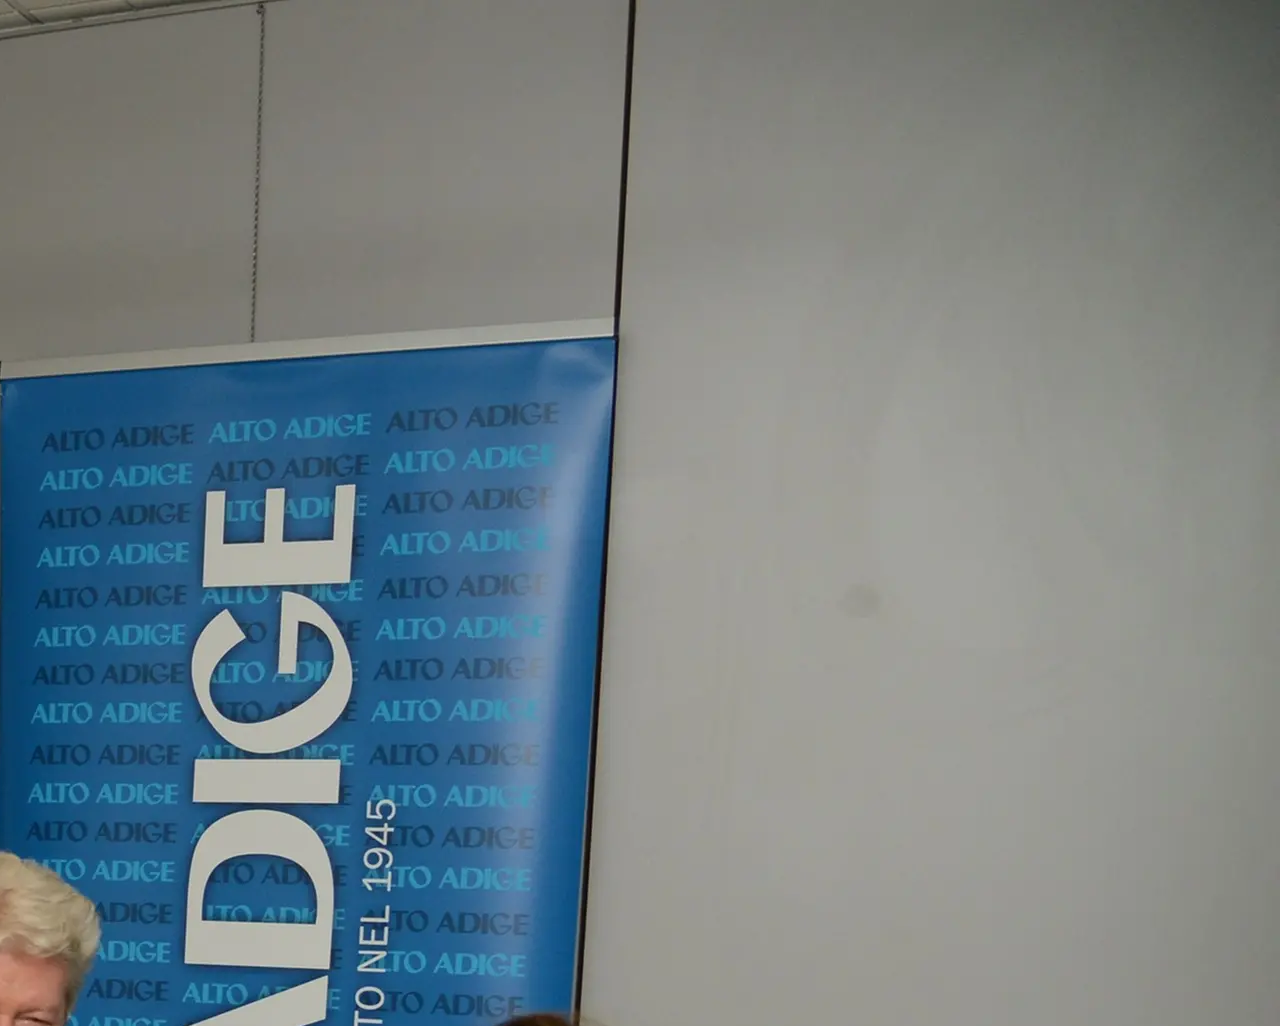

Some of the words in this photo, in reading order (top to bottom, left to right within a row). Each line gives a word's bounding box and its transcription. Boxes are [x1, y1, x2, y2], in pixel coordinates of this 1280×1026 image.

[209, 418, 277, 445] ALTO
[284, 413, 372, 440] ADIGE
[385, 408, 457, 434] ALTO
[465, 402, 559, 429] ADIGE
[41, 428, 105, 453] ALTO
[112, 423, 194, 448] ADIGE
[207, 458, 275, 483] ALTO
[282, 455, 370, 479] ADIGE
[384, 449, 454, 475] ALTO
[462, 444, 556, 469] ADIGE
[40, 468, 103, 491] ALTO
[110, 463, 192, 486] ADIGE
[382, 490, 453, 514] ALTO
[461, 486, 552, 510] ADIGE
[38, 506, 102, 530] ALTO
[108, 503, 190, 527] ADIGE
[36, 545, 100, 568] ALTO
[106, 542, 189, 565] ADIGE
[380, 531, 450, 556] ALTO
[458, 528, 550, 553] ADIGE
[35, 585, 98, 609] ALTO
[104, 584, 187, 607] ADIGE
[34, 625, 97, 648] ALTO
[103, 623, 186, 646] ADIGE
[32, 663, 96, 687] ALTO
[101, 662, 185, 685] ADIGE
[31, 703, 94, 724] ALTO
[99, 702, 182, 724] ADIGE
[29, 744, 92, 766] ALTO
[98, 744, 180, 766] ADIGE
[28, 783, 90, 805] ALTO
[96, 783, 178, 805] ADIGE
[363, 799, 396, 892] 1945
[357, 905, 390, 972] NEL
